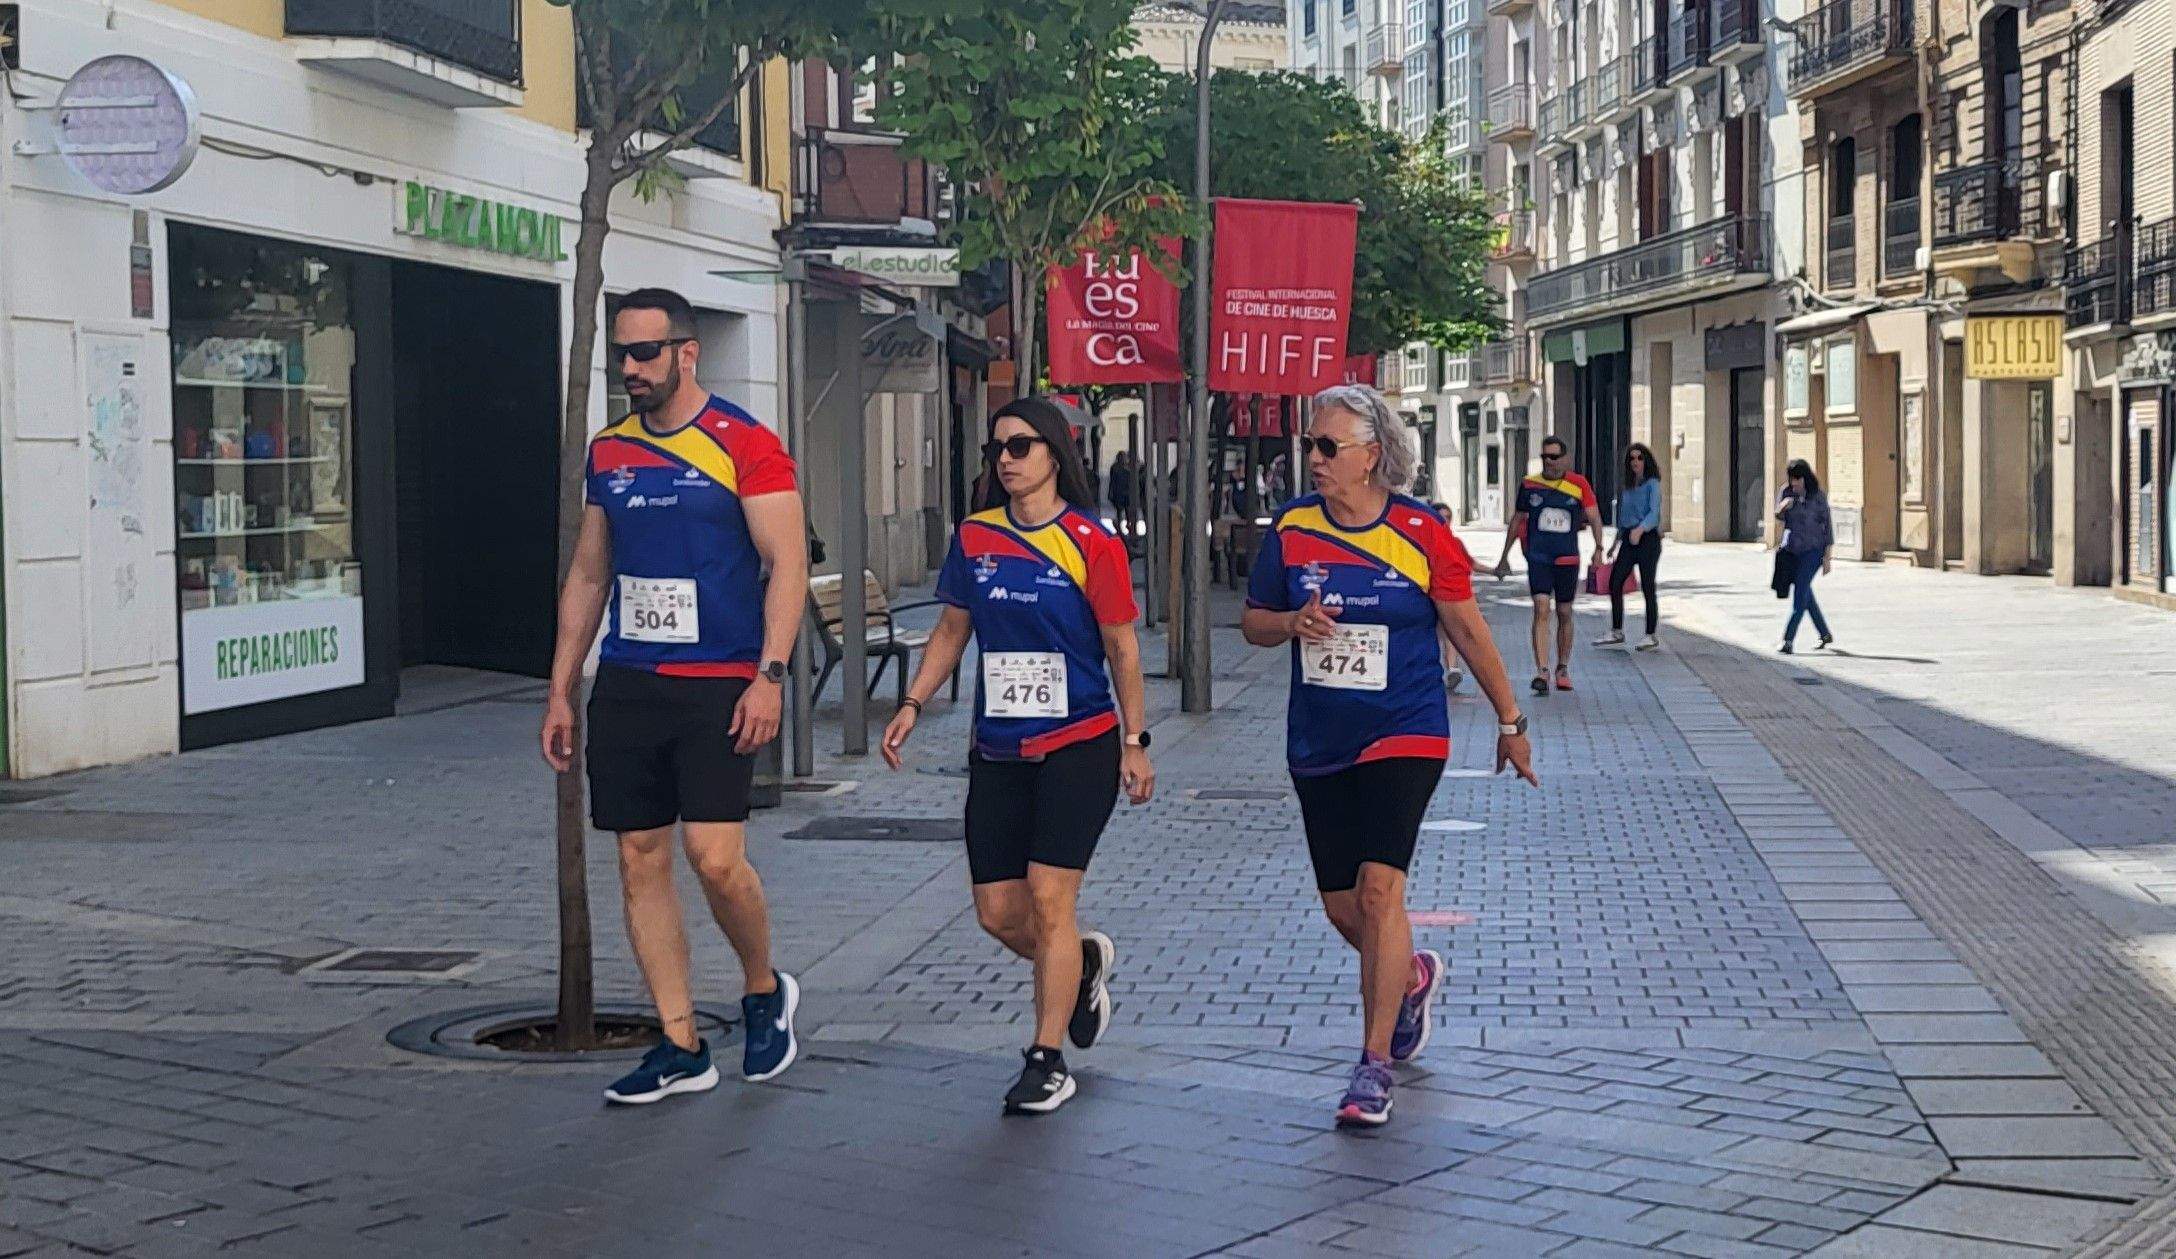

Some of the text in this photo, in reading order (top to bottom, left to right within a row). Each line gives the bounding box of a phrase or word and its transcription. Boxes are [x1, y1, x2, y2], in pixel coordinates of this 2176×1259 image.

[1086, 282, 1139, 319] es
[1226, 288, 1337, 300] FESTIVAL INTERNACIONAL
[1226, 301, 1337, 321] DE CINE DE HUESCA
[1086, 332, 1146, 366] ca
[1221, 330, 1337, 378] HIFF
[1973, 319, 2056, 364] ASCASO
[634, 608, 679, 630] 504
[217, 625, 339, 680] REPARACIONES
[1319, 653, 1368, 675] 474
[1001, 684, 1052, 704] 476
